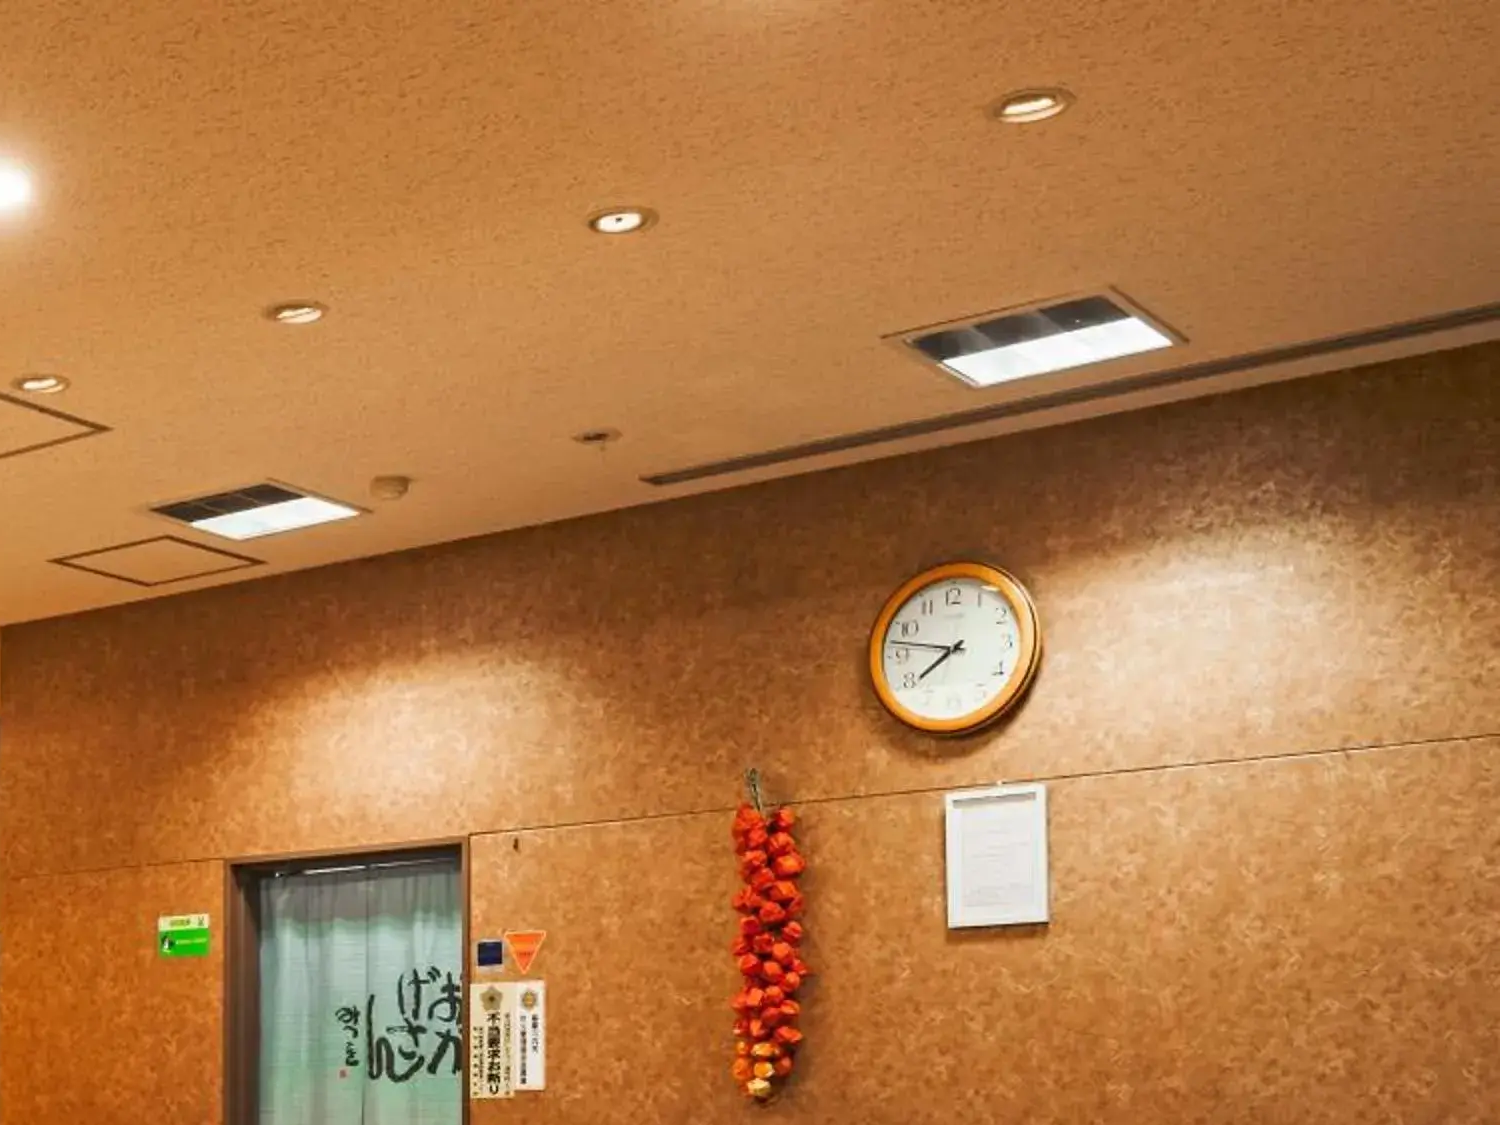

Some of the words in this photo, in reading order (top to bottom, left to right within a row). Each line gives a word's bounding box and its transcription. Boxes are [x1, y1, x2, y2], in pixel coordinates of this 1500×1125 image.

[945, 587, 961, 606] 12
[921, 599, 934, 616] 11
[995, 607, 1007, 625] 2
[900, 619, 919, 637] 10
[903, 672, 916, 689] 8
